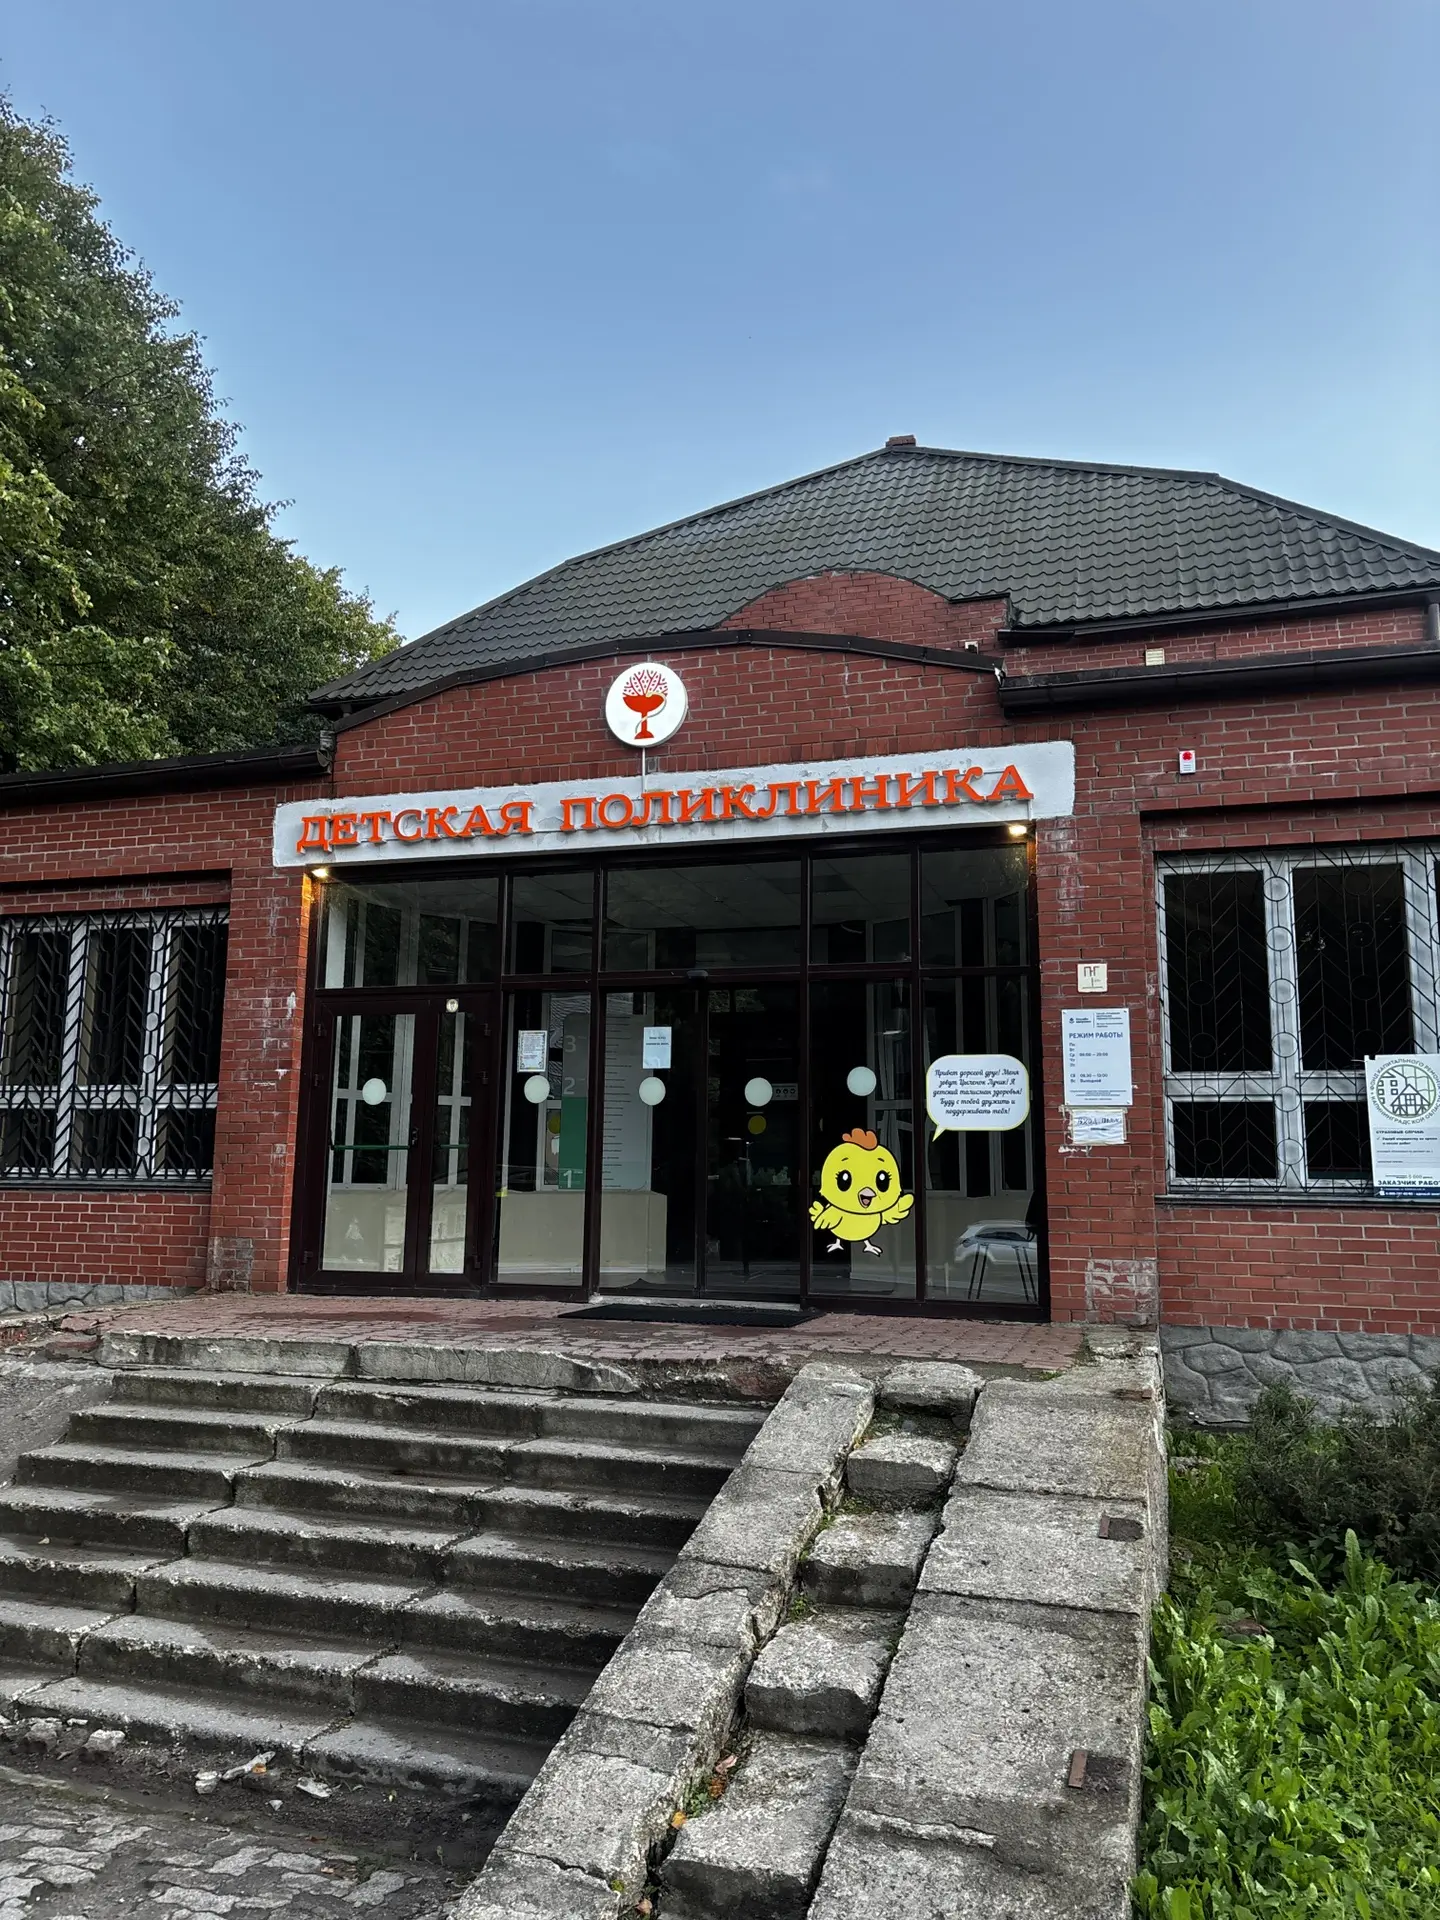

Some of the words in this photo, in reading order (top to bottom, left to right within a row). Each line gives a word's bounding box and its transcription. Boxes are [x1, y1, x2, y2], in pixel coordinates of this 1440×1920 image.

[296, 801, 535, 854] ДЕТСКАЯ
[558, 764, 1035, 832] ПОЛИКЛИНИКА
[1095, 1031, 1123, 1039] РАБОТЫ
[1377, 1058, 1424, 1074] КАПИТАЛЬНОГО
[934, 1069, 958, 1078] Привет
[959, 1069, 983, 1078] дорогой
[984, 1069, 1001, 1078] друг!
[563, 1076, 576, 1095] 2
[938, 1079, 958, 1088] зовут
[932, 1088, 958, 1097] детский
[992, 1088, 1023, 1097] здоровья!
[940, 1098, 955, 1107] Буду
[981, 1099, 1010, 1107] дружить
[945, 1108, 991, 1117] поддерживать
[1370, 1096, 1425, 1125] КАЛИНИНГРАДСКОЙ
[562, 1170, 573, 1189] 1
